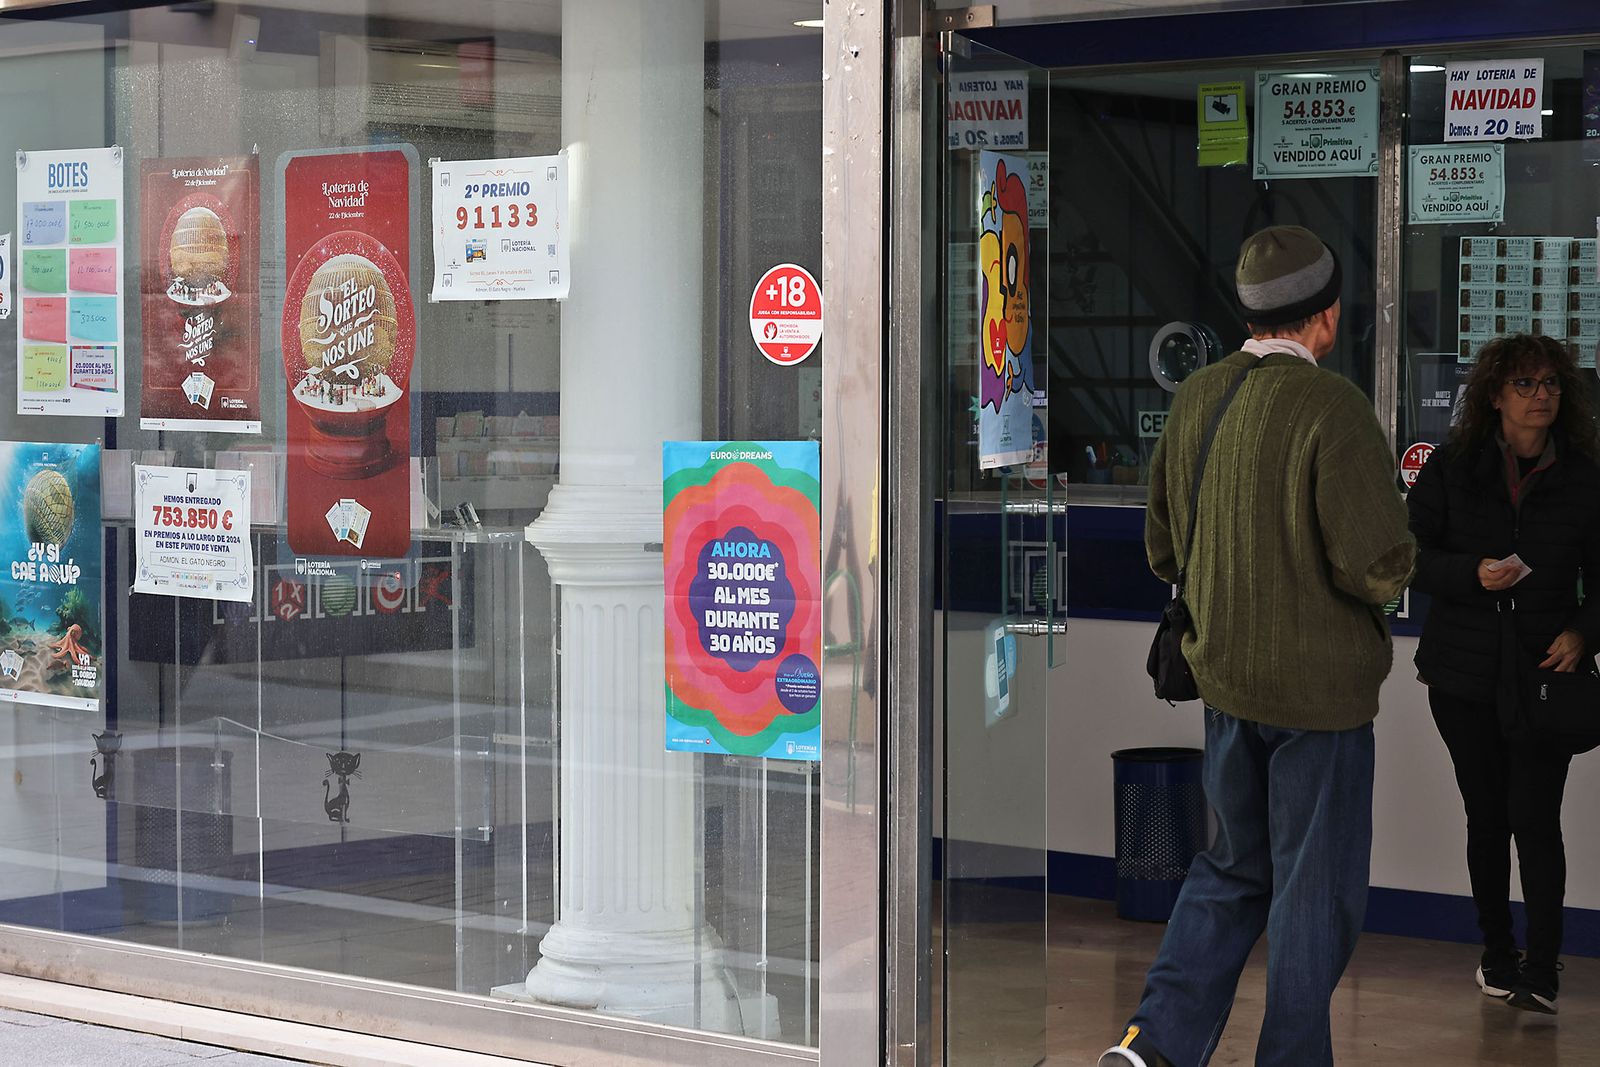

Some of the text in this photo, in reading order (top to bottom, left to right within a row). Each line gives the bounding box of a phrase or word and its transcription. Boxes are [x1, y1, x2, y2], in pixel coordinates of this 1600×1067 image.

[1450, 68, 1537, 82] HAY LOTERIA DE
[1272, 79, 1366, 96] GRAN PREMIO
[1450, 88, 1536, 111] NAVIDAD
[1284, 99, 1345, 119] 54.853
[1474, 126, 1478, 136] a
[1484, 119, 1508, 136] 20
[1514, 120, 1534, 135] Euros
[1323, 138, 1352, 146] Primitiva
[1274, 146, 1362, 162] VENDIDO AQUÍ
[1420, 153, 1492, 165] GRAN PREMIO
[48, 162, 88, 188] BOTES
[196, 168, 203, 176] de
[204, 164, 229, 176] Navidad
[1430, 167, 1476, 181] 54.853
[322, 180, 369, 196] Lotería de
[465, 181, 530, 199] 2º PREMIO
[328, 192, 369, 208] Navidad
[1422, 200, 1489, 212] VENDIDO AQUÍ
[456, 203, 538, 230] 91133
[339, 277, 358, 299] EL
[766, 276, 806, 307] +18
[316, 284, 376, 333] SORTEO
[339, 322, 353, 336] QUE
[322, 323, 375, 369] NOS UNE
[163, 495, 221, 506] HEMOS ENTREGADO
[152, 505, 233, 530] 753.850 €
[144, 530, 153, 538] EN
[153, 530, 180, 540] PREMIOS
[187, 533, 195, 541] LO
[196, 533, 216, 542] LARGO
[217, 535, 226, 543] DE
[226, 535, 240, 544] 2024
[28, 542, 60, 563] ¿Y SI
[165, 541, 179, 549] ESTE
[180, 542, 201, 551] PUNTO
[210, 544, 230, 553] VENTA
[711, 541, 771, 558] AHORA
[11, 558, 81, 585] CAE AQUÍ?
[206, 559, 226, 567] NEGRO
[308, 560, 331, 569] LOTERÍA
[714, 586, 770, 605] AL MES
[705, 610, 780, 630] DURANTE
[710, 631, 776, 654] 30 AÑOS
